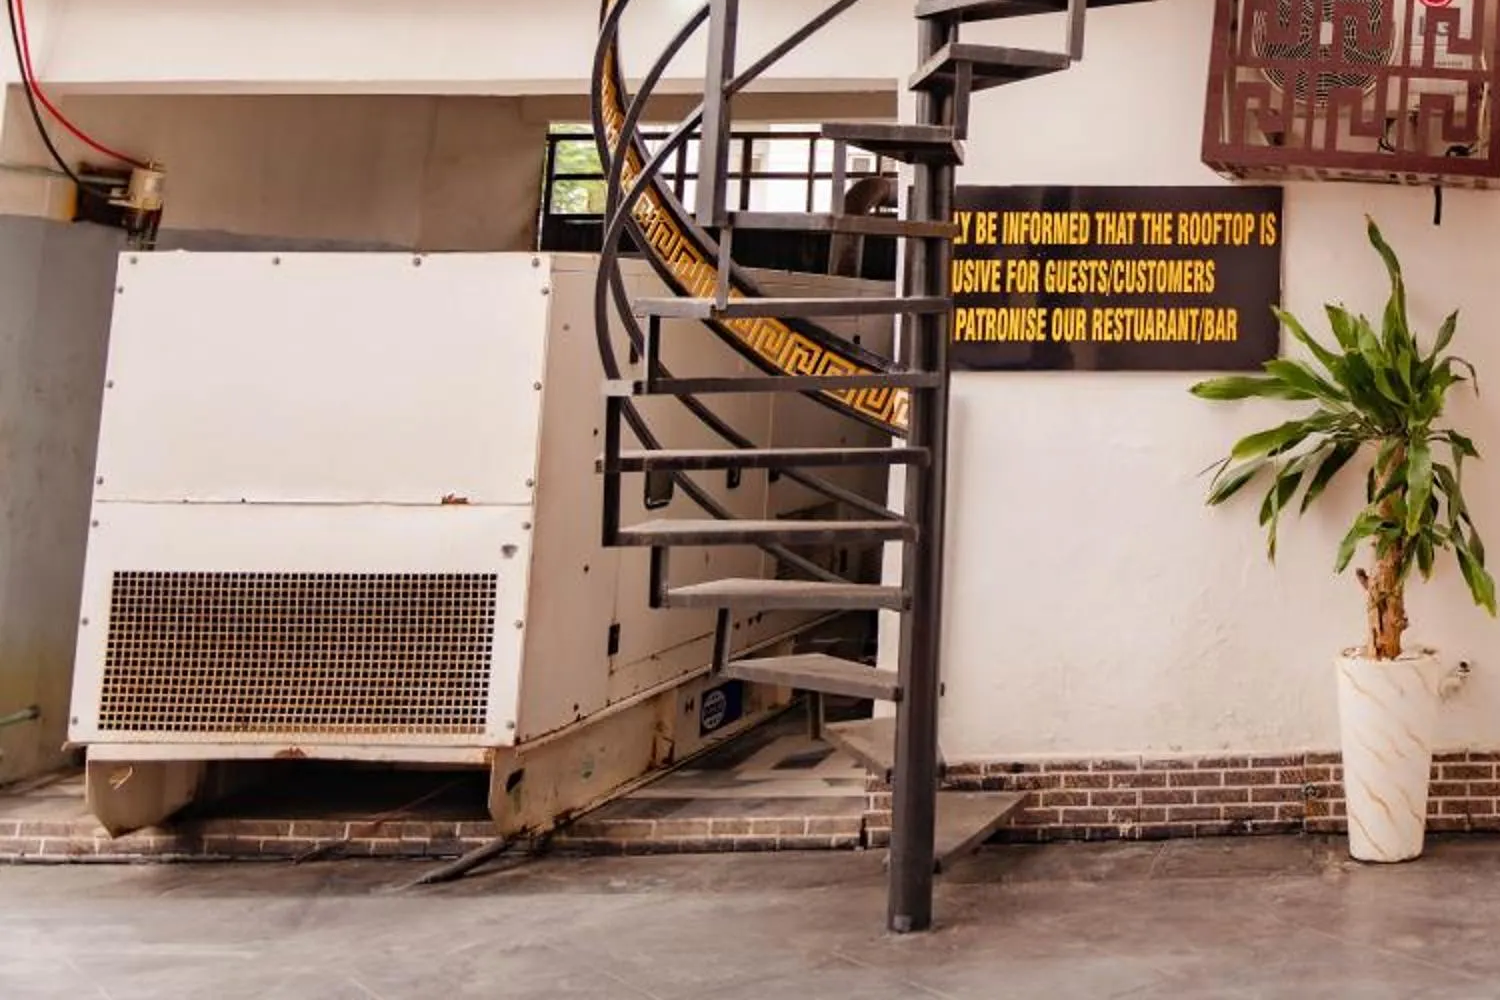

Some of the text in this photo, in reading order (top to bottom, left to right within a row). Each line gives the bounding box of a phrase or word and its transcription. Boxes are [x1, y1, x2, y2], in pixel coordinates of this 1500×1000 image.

[975, 211, 998, 245] BE
[1001, 211, 1090, 245] INFORMED
[1095, 211, 1137, 245] THAT
[1141, 212, 1173, 245] THE
[1177, 212, 1255, 246] ROOFTOP
[1259, 213, 1277, 246] IS
[952, 259, 1216, 296] USIVE FOR GUESTS/CUSTOMERS
[955, 307, 1047, 342] PATRONISE
[1051, 308, 1087, 342] OUR
